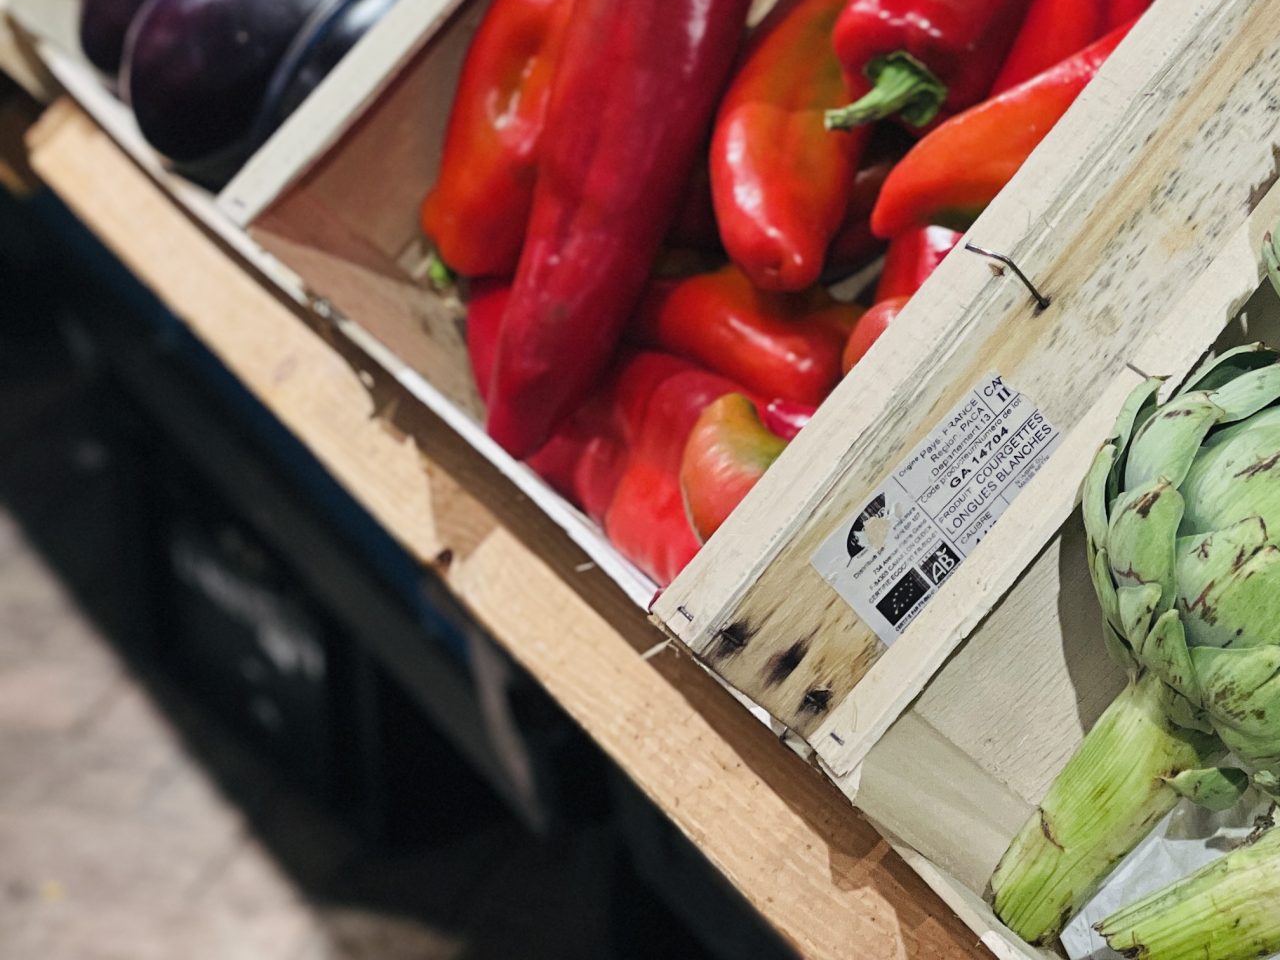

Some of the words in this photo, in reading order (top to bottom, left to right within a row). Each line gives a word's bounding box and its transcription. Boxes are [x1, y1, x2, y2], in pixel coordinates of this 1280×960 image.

[997, 387, 1011, 402] II
[942, 399, 978, 435] FRANCE
[960, 407, 984, 432] PACA
[980, 413, 991, 424] 13
[899, 457, 919, 477] Origine
[921, 484, 940, 503] Code
[1002, 408, 1012, 419] de
[939, 487, 971, 523] PRODUIT
[976, 413, 1043, 484] COURGETTES
[950, 468, 971, 488] GA
[972, 427, 1008, 464] 14704
[946, 481, 997, 534] LONGUES
[996, 424, 1051, 482] BLANCHES
[961, 511, 992, 544] CALIBRE
[925, 551, 956, 583] AB
